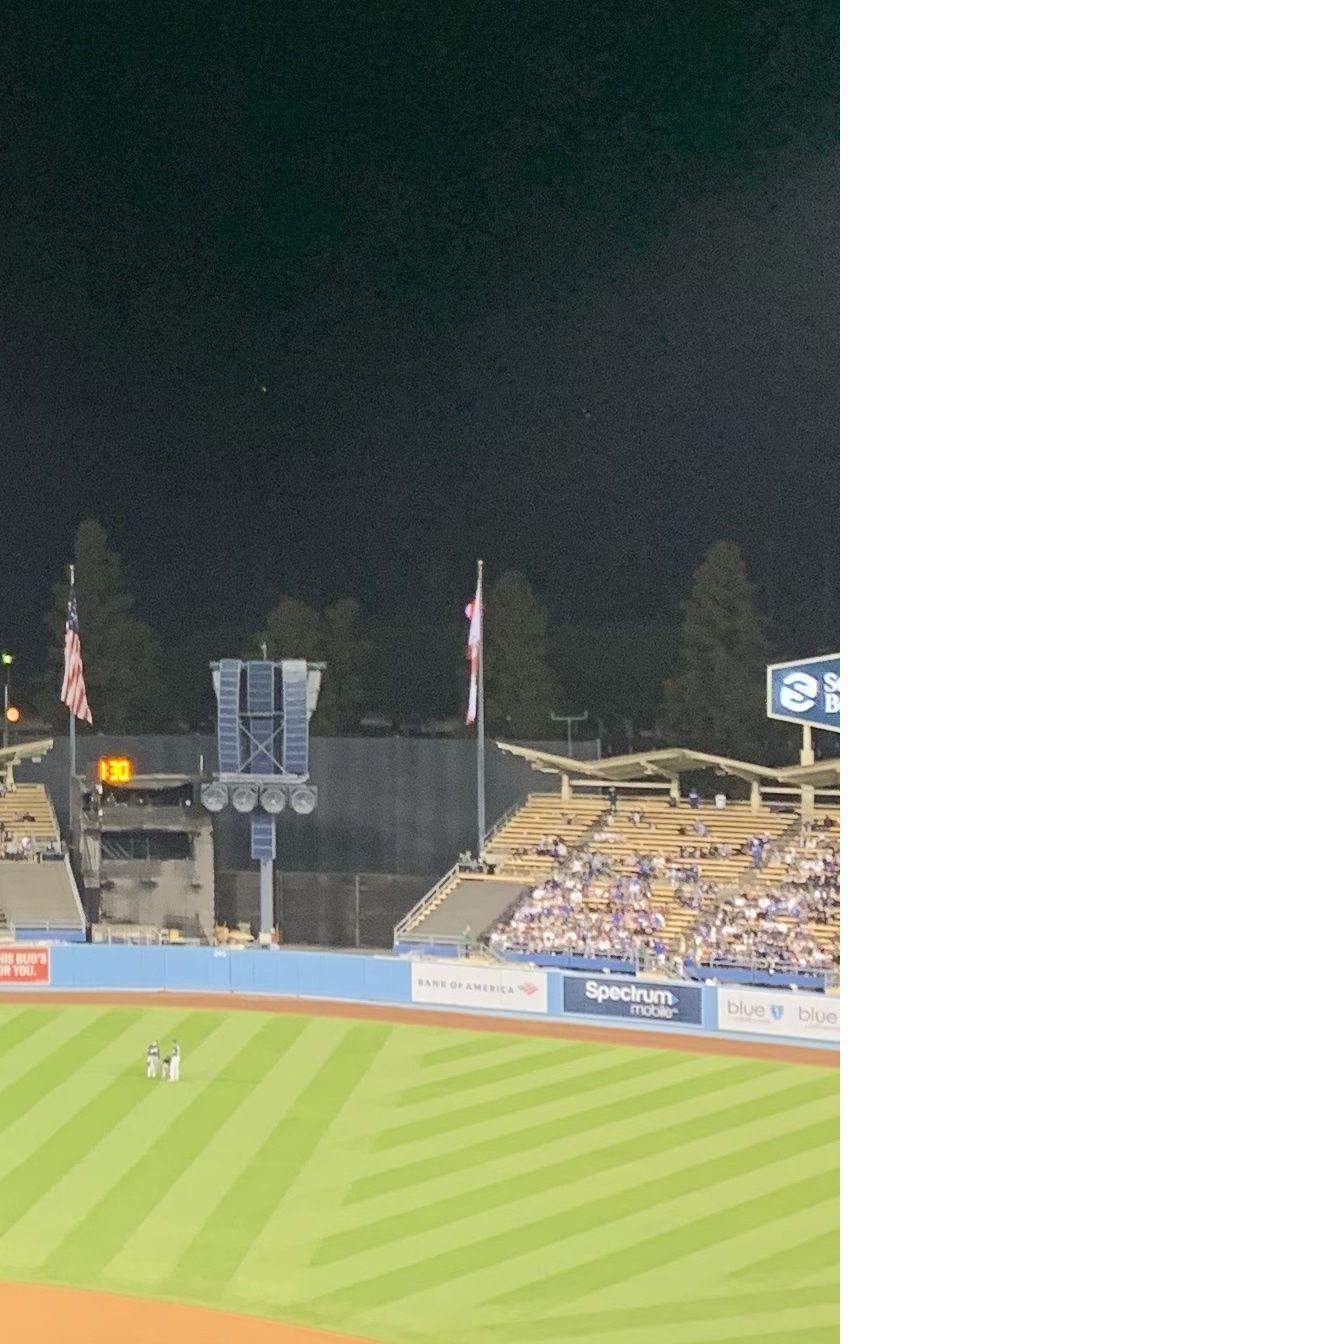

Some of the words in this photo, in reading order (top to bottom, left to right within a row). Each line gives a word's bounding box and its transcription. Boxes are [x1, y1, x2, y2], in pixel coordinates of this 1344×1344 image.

[417, 978, 447, 989] BANK
[450, 982, 465, 991] OF
[465, 983, 515, 995] AMERICA
[585, 981, 673, 1006] Spectrum
[630, 1003, 673, 1018] mobile
[727, 999, 765, 1017] blue
[798, 1006, 838, 1024] blue
